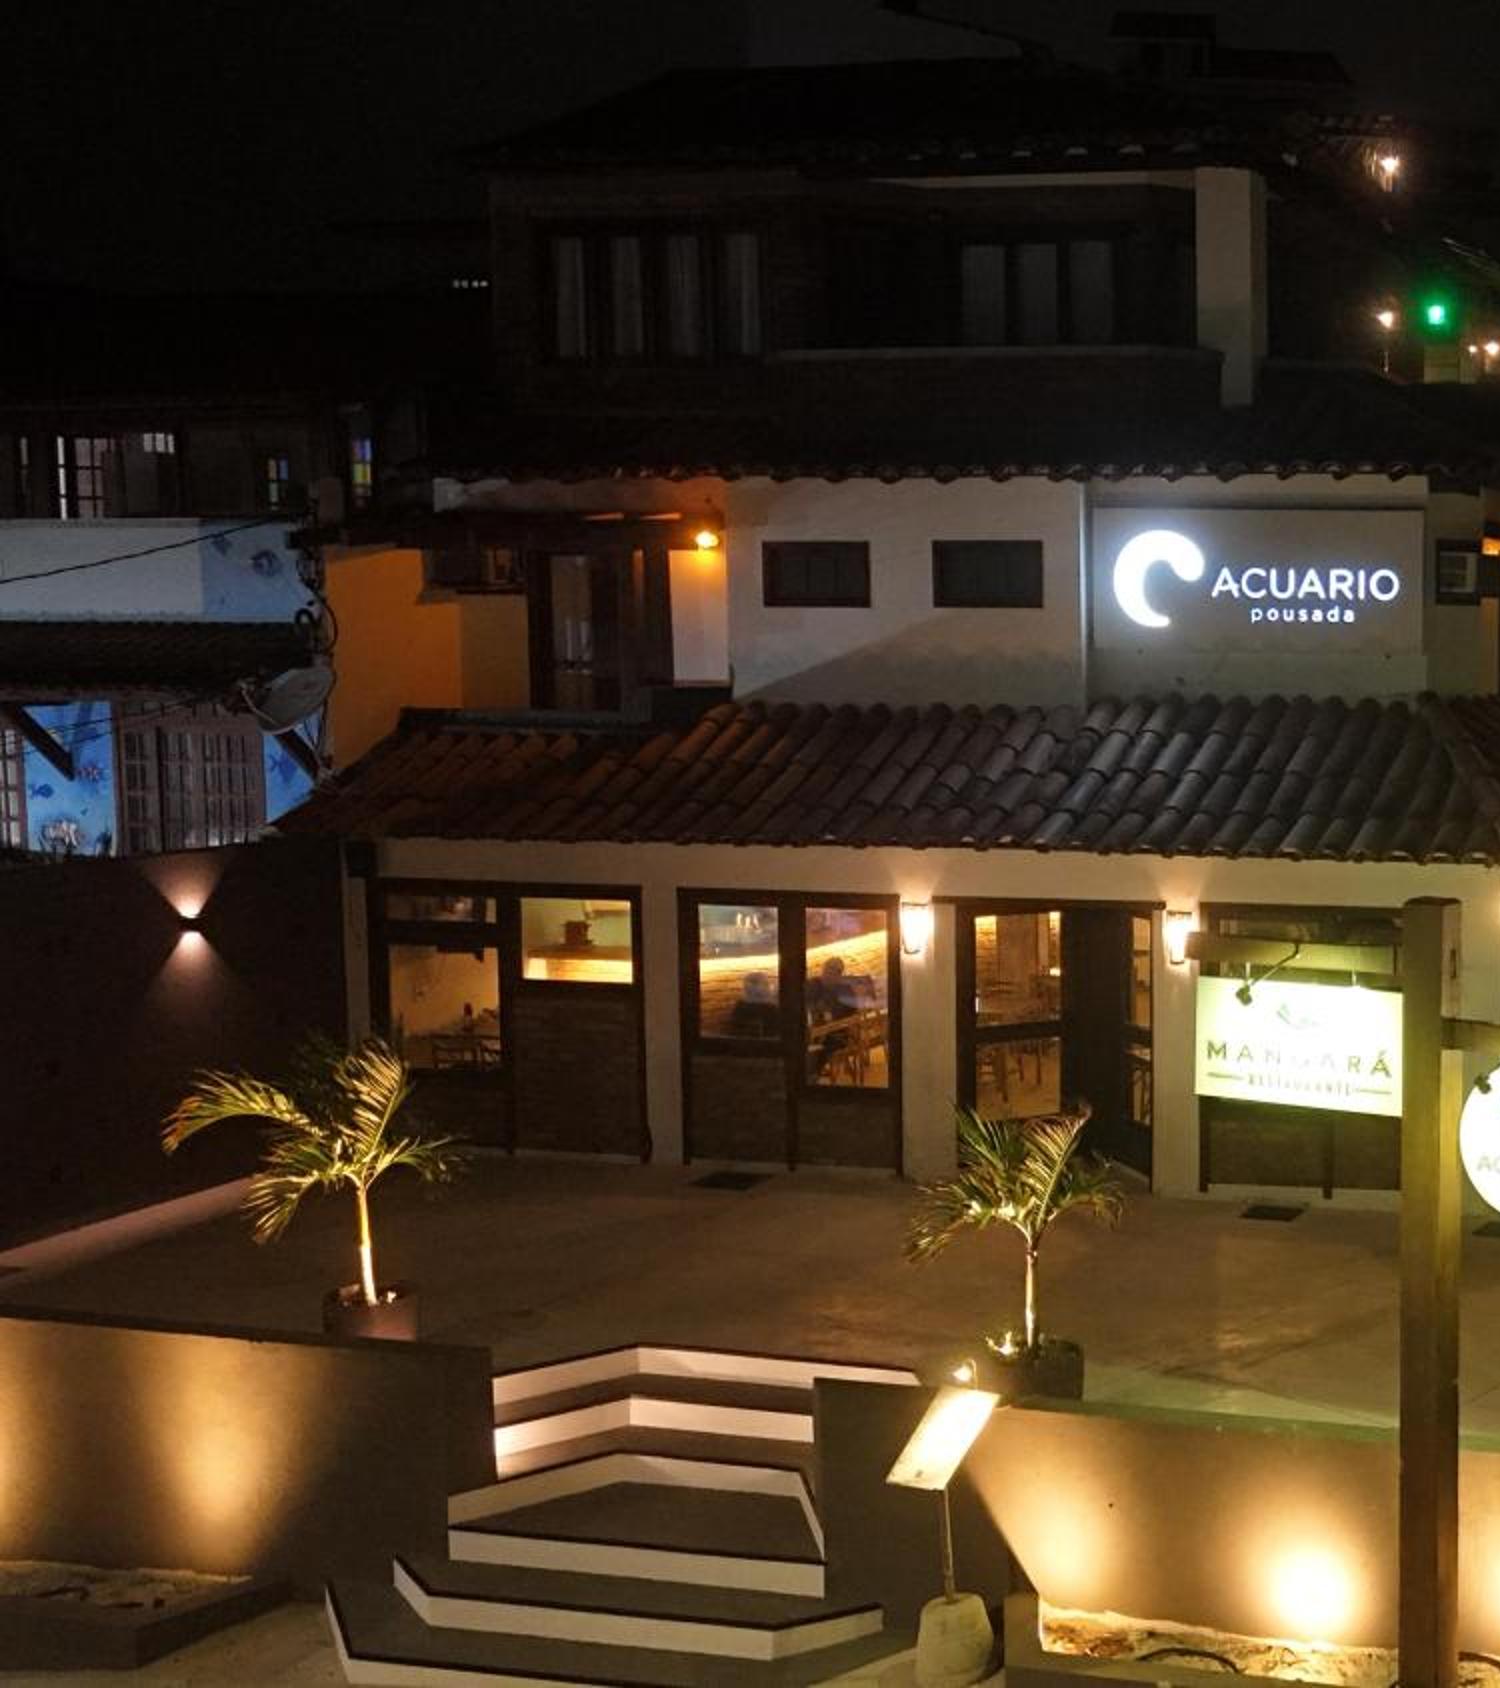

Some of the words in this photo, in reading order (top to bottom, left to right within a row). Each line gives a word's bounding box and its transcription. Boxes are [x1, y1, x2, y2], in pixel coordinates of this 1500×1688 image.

[1211, 566, 1400, 601] ACUARIO
[1250, 605, 1356, 623] pousada
[1206, 1040, 1393, 1079] MANARÁ
